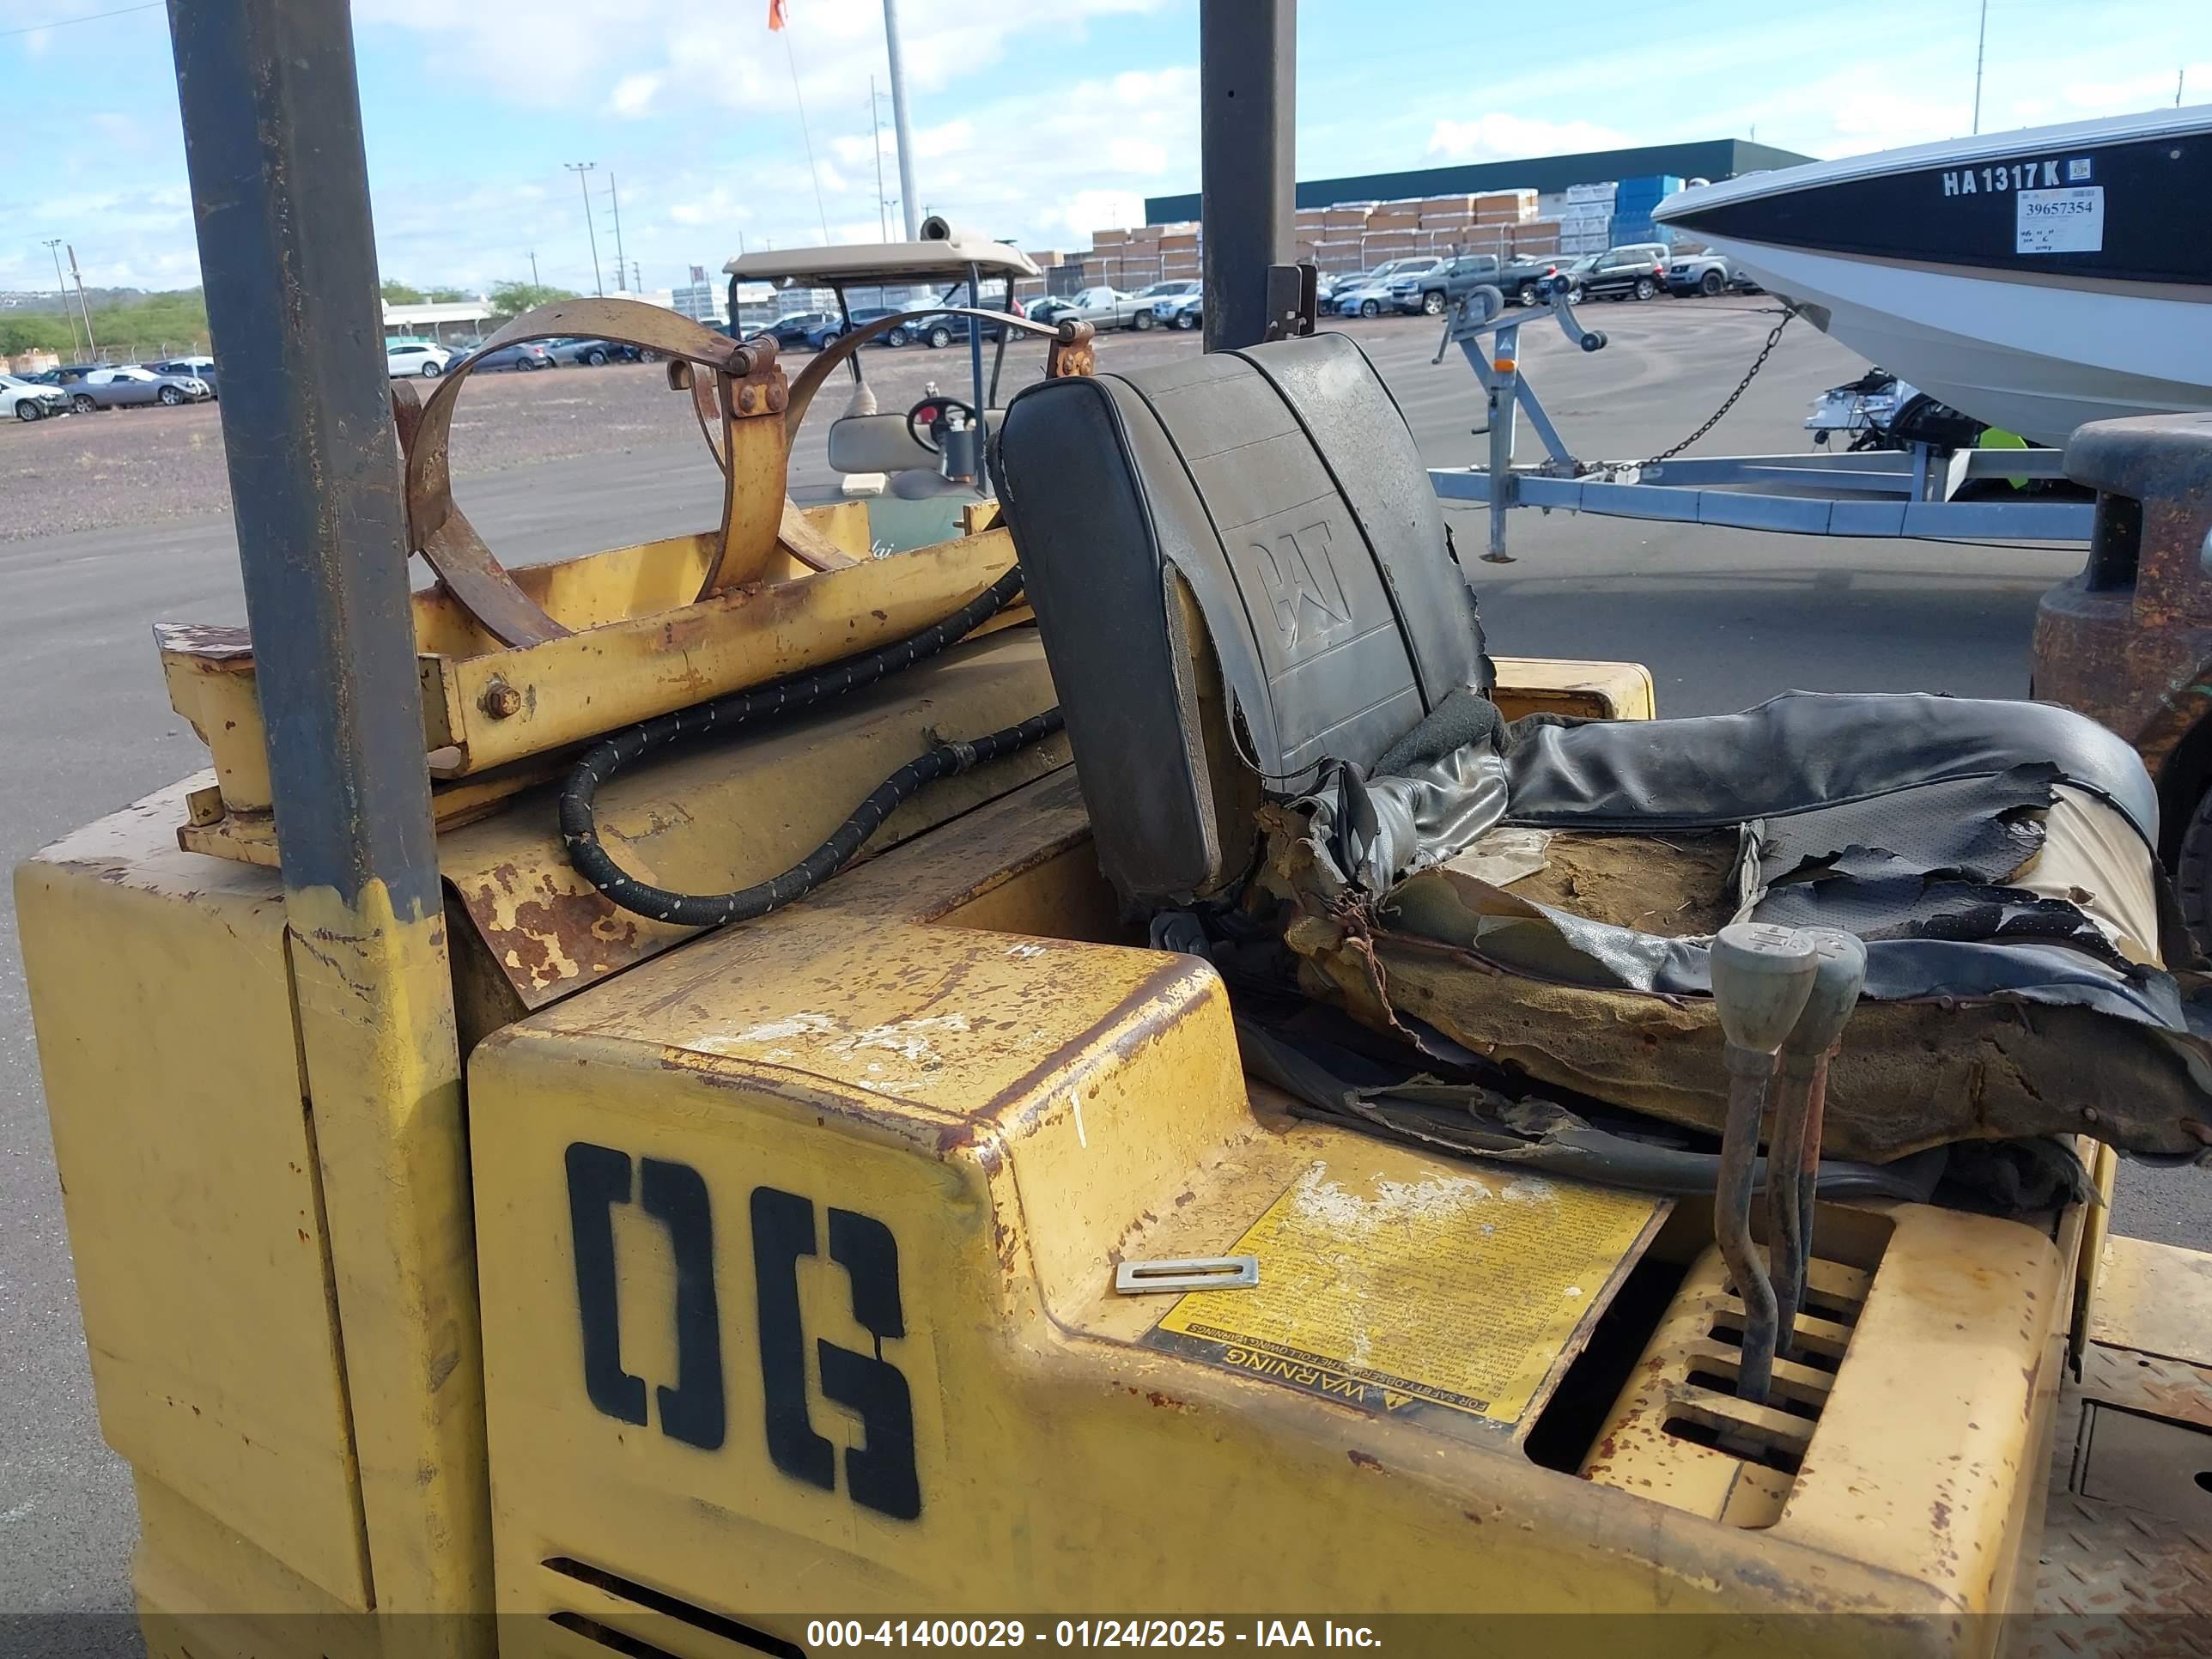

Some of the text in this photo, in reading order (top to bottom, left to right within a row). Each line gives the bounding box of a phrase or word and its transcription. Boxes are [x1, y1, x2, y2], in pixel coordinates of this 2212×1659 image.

[1943, 170, 1977, 197] HA
[1982, 163, 2038, 192] 1317
[2044, 160, 2060, 186] K
[2027, 201, 2093, 216] 39657354
[1245, 519, 1352, 649] CAT
[1320, 1357, 1342, 1370] THE
[1224, 1351, 1364, 1403] WARNING
[1461, 1397, 1487, 1411] FOR
